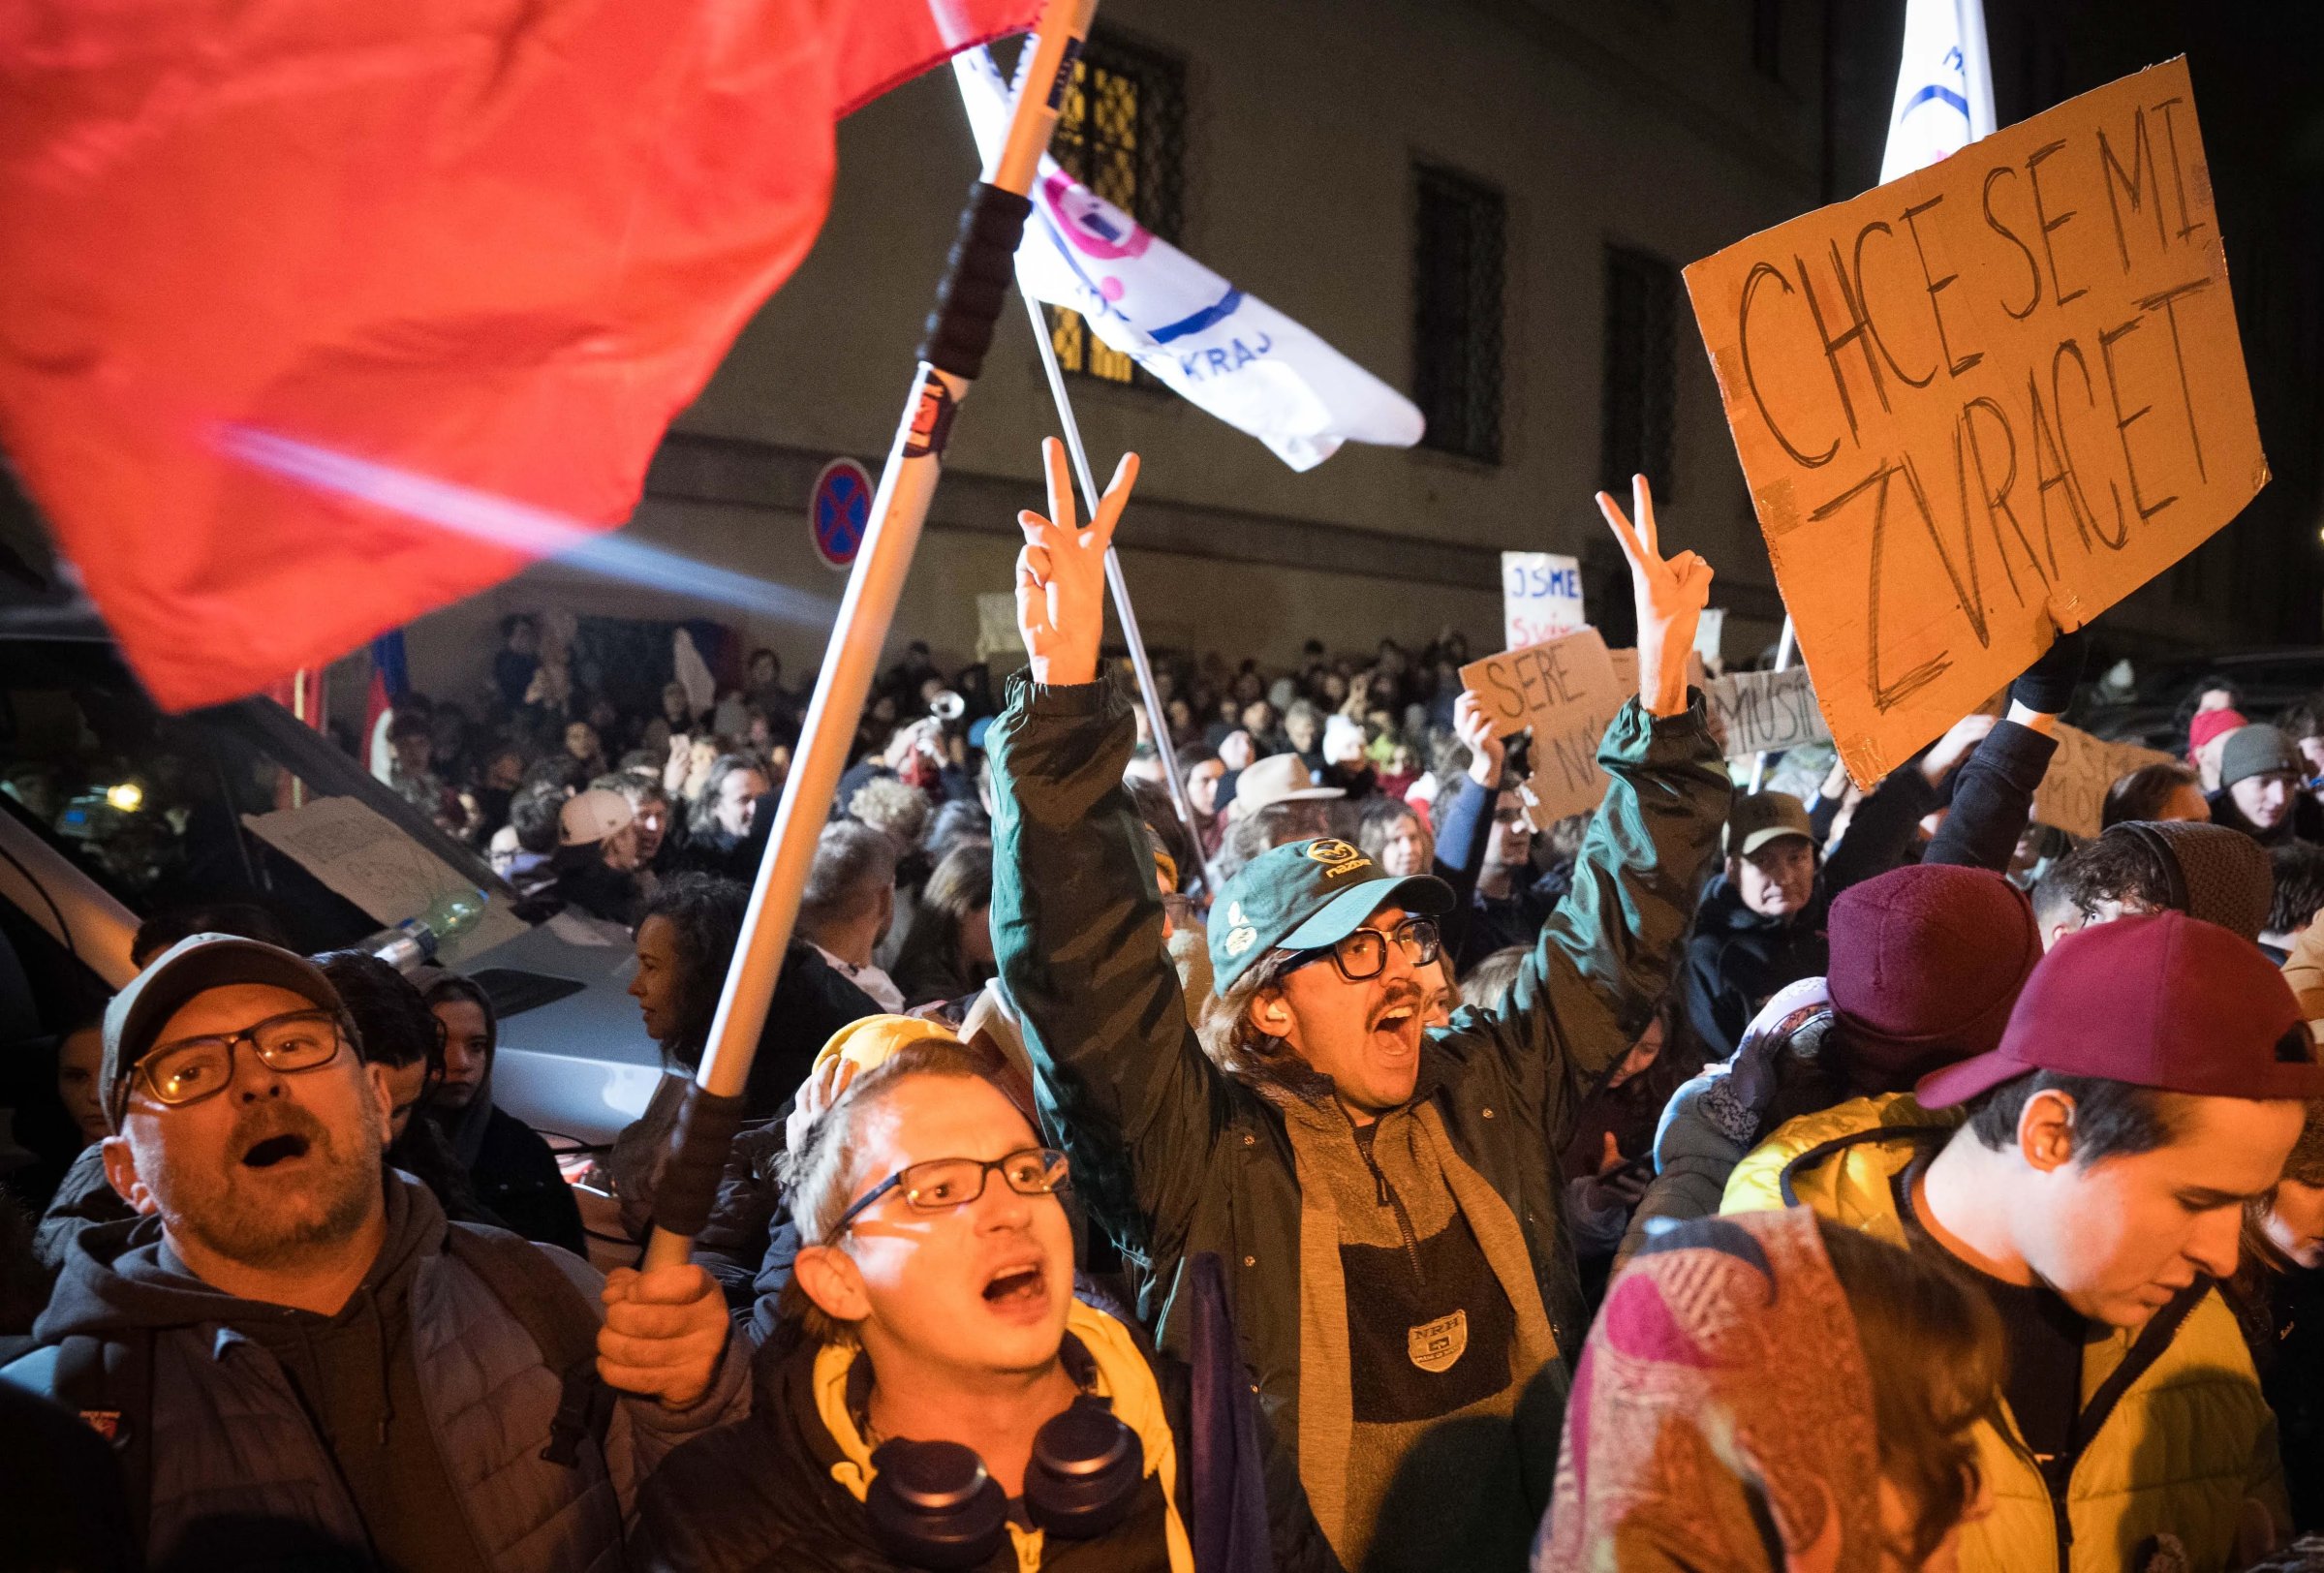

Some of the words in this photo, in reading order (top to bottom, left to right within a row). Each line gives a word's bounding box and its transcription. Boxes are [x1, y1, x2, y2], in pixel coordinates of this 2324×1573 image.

[1739, 194, 1984, 469] CHCE
[1982, 139, 2090, 321] SE
[2095, 98, 2206, 275] MI
[1179, 331, 1272, 381] KRAJ
[1808, 277, 2212, 714] ZVRACET
[1512, 567, 1579, 598] JSME
[1486, 643, 1587, 718] SERE
